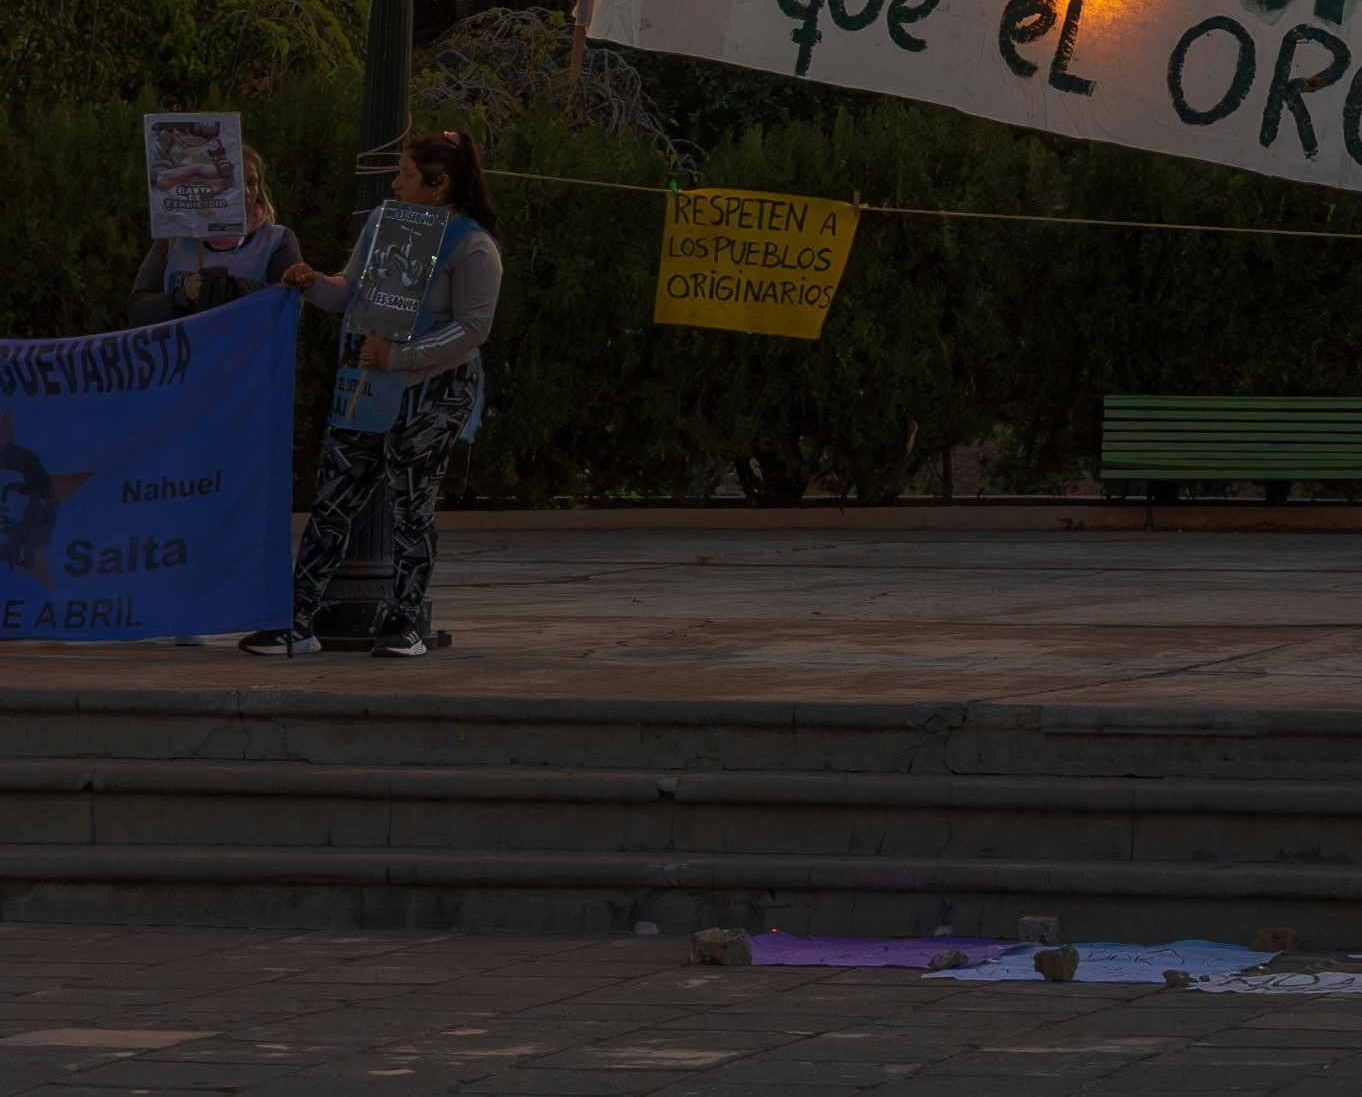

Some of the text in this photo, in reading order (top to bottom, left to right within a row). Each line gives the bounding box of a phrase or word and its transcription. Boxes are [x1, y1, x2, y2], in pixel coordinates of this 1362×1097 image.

[674, 192, 837, 237] RESPETEN A
[669, 235, 832, 272] LOS PUEBLOS
[0, 321, 192, 396] GUEVARISTA
[121, 470, 223, 503] Nahuel
[63, 535, 188, 577] Salta
[33, 596, 144, 629] ABRIL
